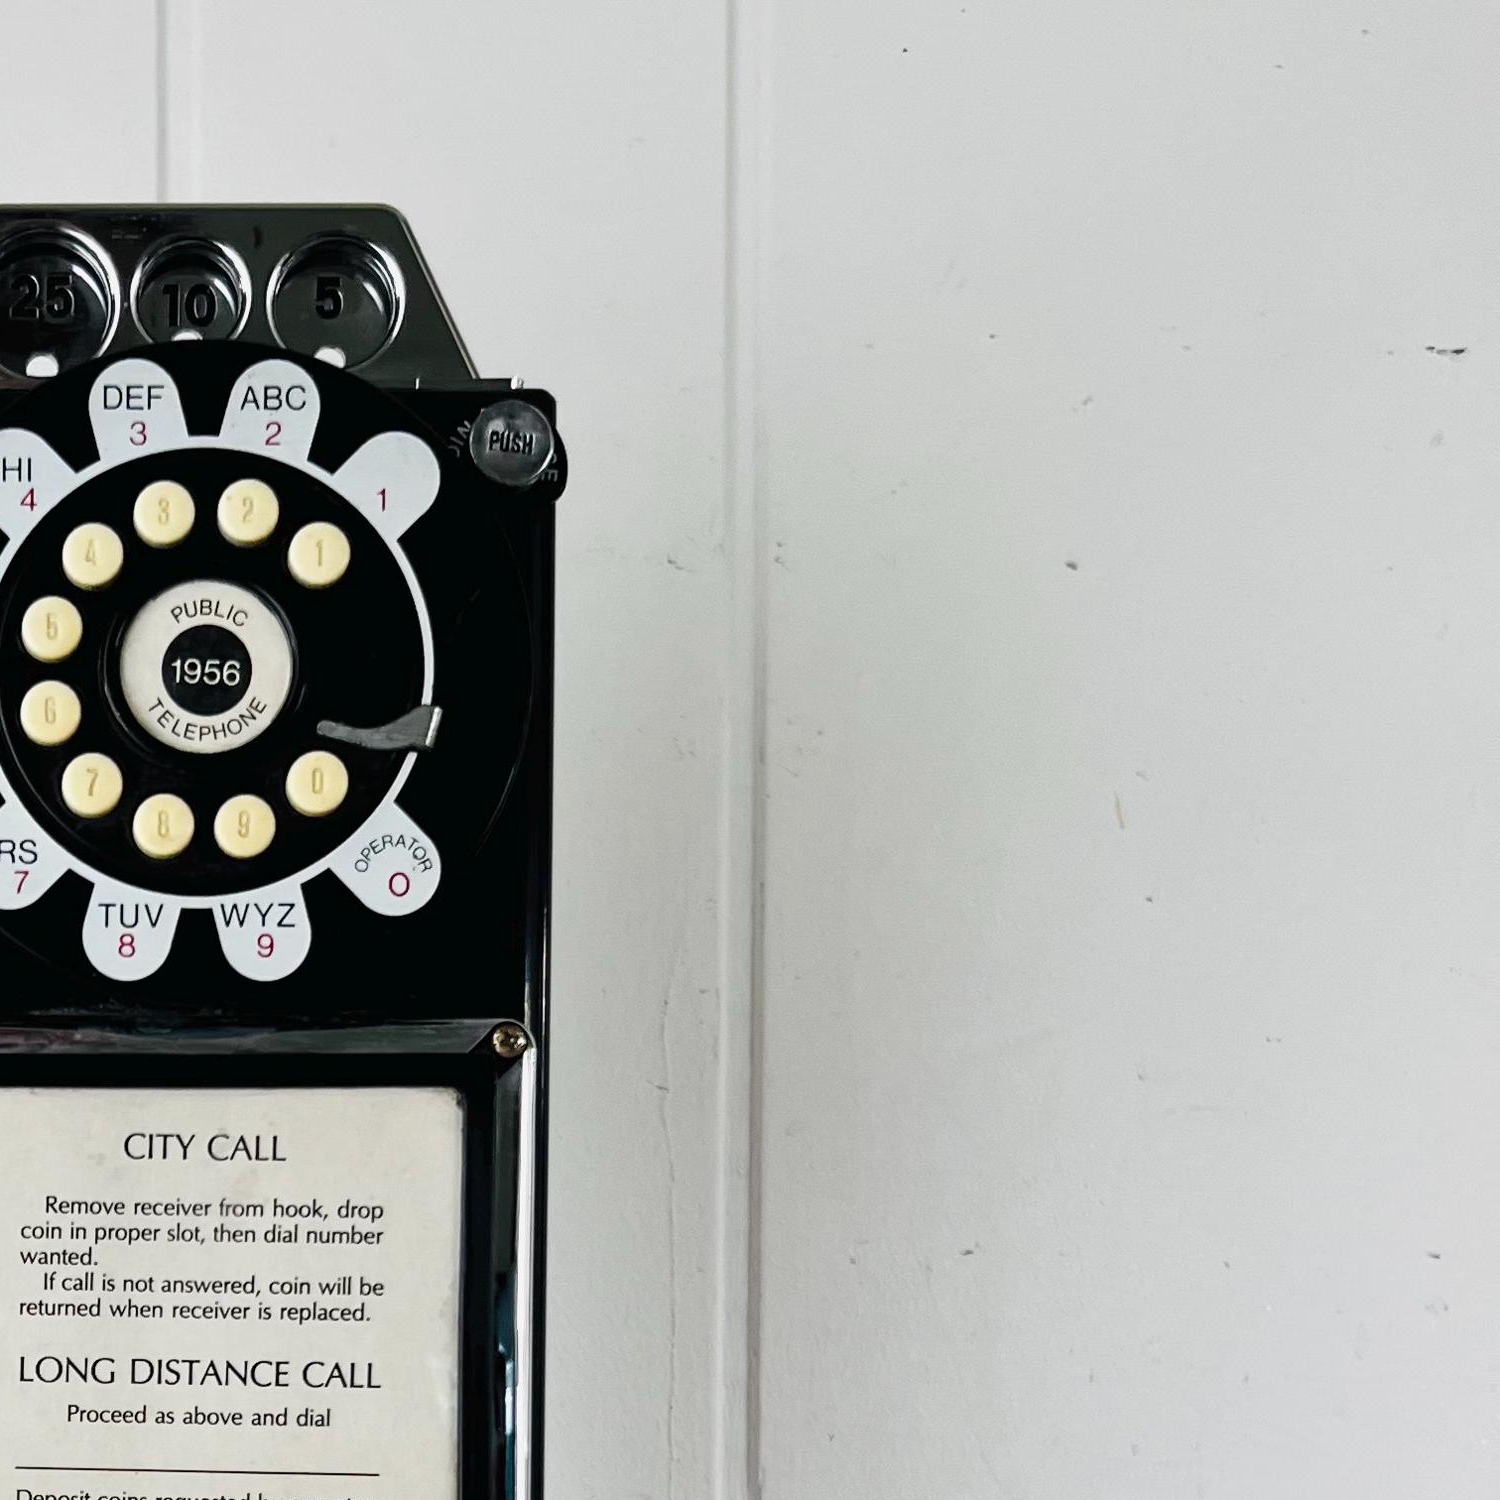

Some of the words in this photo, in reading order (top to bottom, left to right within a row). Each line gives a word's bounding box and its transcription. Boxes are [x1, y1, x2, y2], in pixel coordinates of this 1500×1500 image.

[9, 273, 77, 322] 25
[162, 283, 219, 328] 10
[315, 276, 344, 320] 5
[102, 384, 165, 411] DEF
[240, 384, 307, 411] ABC
[128, 420, 148, 446] 3
[264, 421, 282, 447] 2
[487, 429, 535, 455] PUSH
[19, 487, 38, 512] 4
[156, 497, 170, 526] 3
[241, 496, 255, 523] 2
[376, 487, 387, 512] 1
[84, 539, 97, 567] 4
[315, 539, 324, 568] 1
[45, 612, 58, 641] 5
[170, 599, 249, 627] PUBLIC
[171, 656, 241, 687] 1956
[44, 696, 57, 725] 6
[148, 696, 268, 742] TELEPHONE
[86, 767, 100, 797] 7
[311, 767, 324, 795] 0
[156, 809, 170, 839] 8
[237, 809, 251, 839] 9
[354, 834, 433, 874] OPERATOR
[13, 870, 30, 895] 7
[98, 903, 164, 929] TUV
[220, 903, 296, 929] WYZ
[117, 932, 137, 959] 8
[256, 932, 276, 959] 9
[123, 1132, 196, 1161] CITY
[207, 1134, 287, 1162] CALL
[45, 1195, 126, 1216] Remove
[134, 1197, 212, 1217] receiver
[218, 1198, 264, 1218] from
[273, 1197, 329, 1221] hook,
[337, 1199, 384, 1224] drop
[20, 1220, 62, 1240] coin
[70, 1221, 87, 1240] in
[94, 1226, 160, 1245] proper
[166, 1222, 205, 1244] slot,
[213, 1223, 256, 1243] then
[263, 1223, 299, 1244] dial
[306, 1224, 384, 1245] number
[19, 1246, 98, 1266] wanted.
[43, 1271, 56, 1291] If
[61, 1272, 95, 1292] call
[102, 1273, 116, 1292] is
[122, 1275, 154, 1293] not
[160, 1274, 261, 1298] answered,
[268, 1276, 311, 1295] coin
[318, 1275, 352, 1296] will
[359, 1276, 385, 1297] be
[19, 1297, 101, 1317] returned
[109, 1298, 164, 1319] when
[172, 1300, 251, 1320] receiver
[258, 1301, 272, 1321] is
[280, 1301, 371, 1326] replaced.
[19, 1356, 115, 1385] LONG
[130, 1358, 290, 1388] DISTANCE
[302, 1361, 382, 1389] CALL
[67, 1404, 147, 1424] Proceed
[154, 1410, 175, 1425] as
[182, 1405, 243, 1426] above
[251, 1407, 288, 1427] and
[296, 1407, 331, 1428] dial
